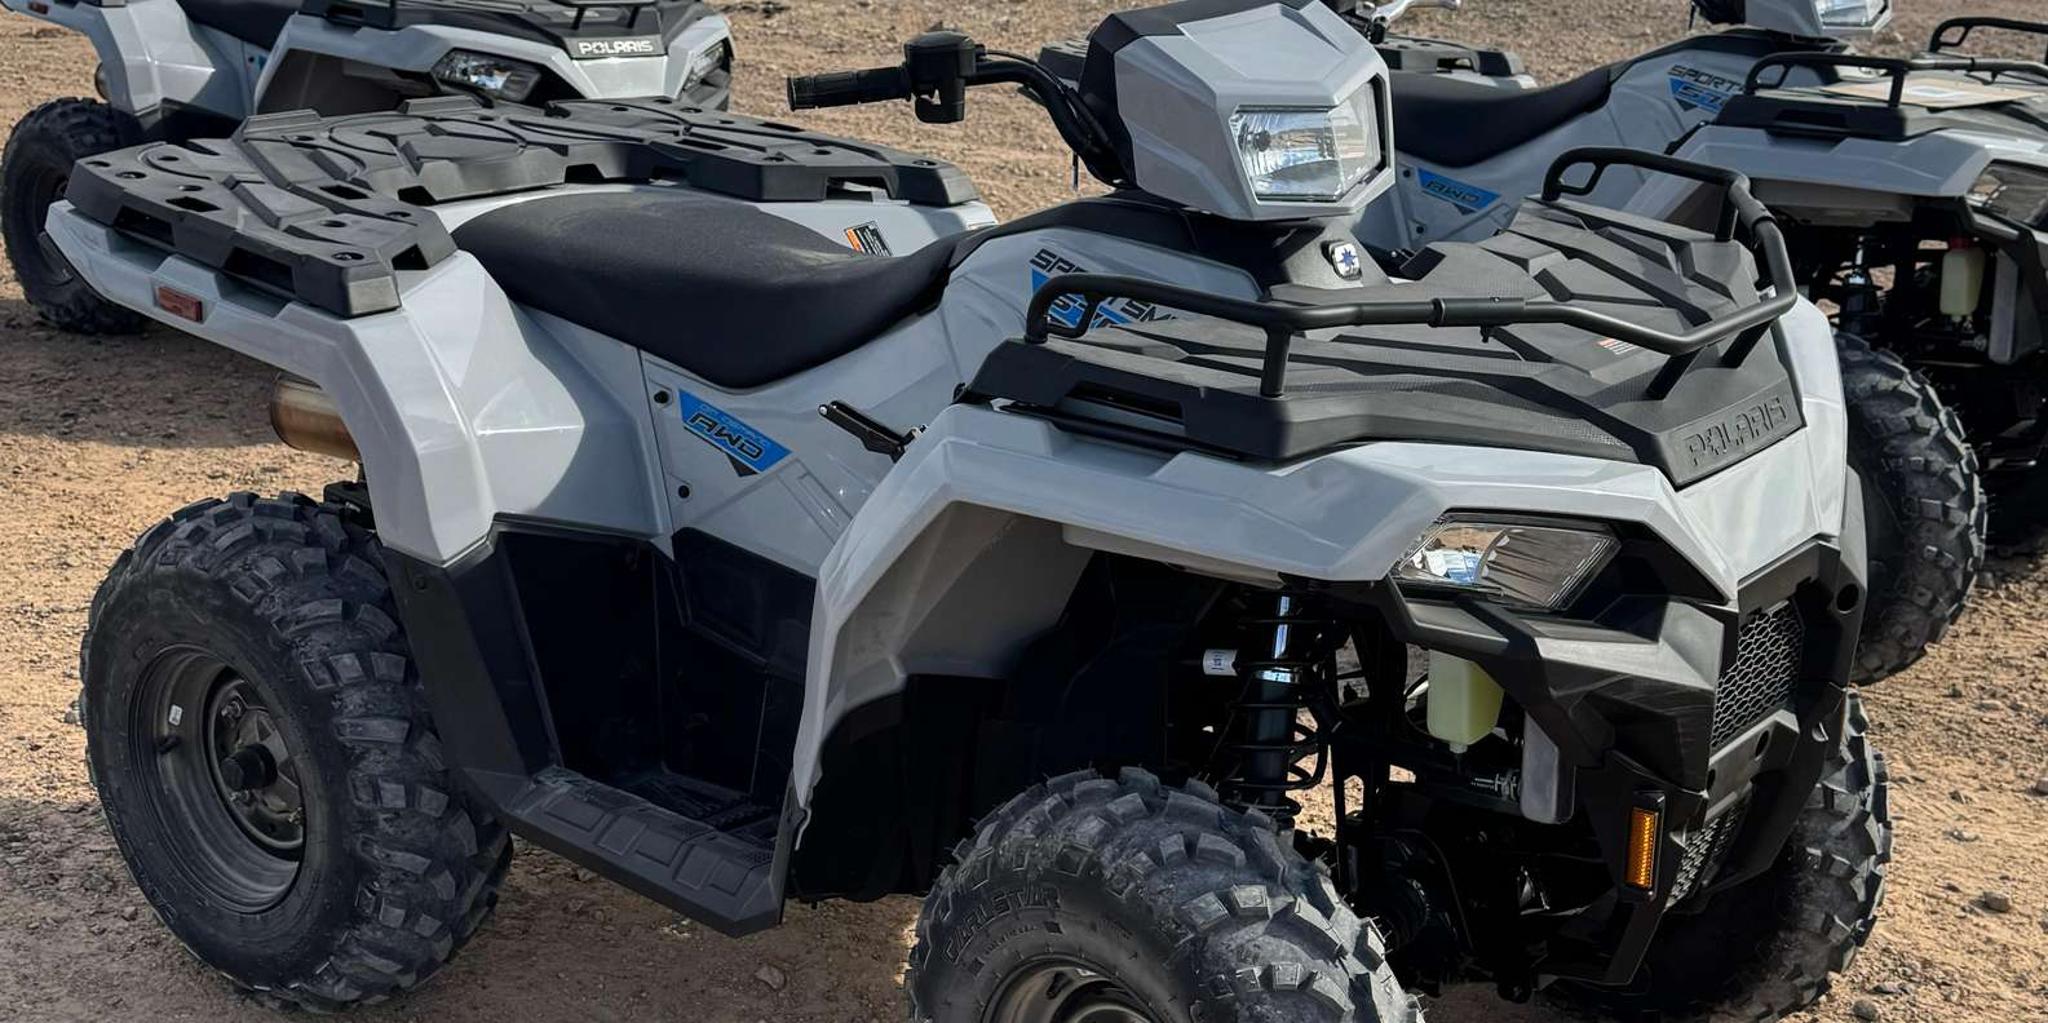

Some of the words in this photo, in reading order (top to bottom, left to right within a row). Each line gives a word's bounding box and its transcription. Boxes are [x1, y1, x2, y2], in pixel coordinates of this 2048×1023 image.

[578, 40, 654, 55] POLARIS
[687, 411, 764, 460] AWD
[1683, 396, 1788, 467] POLARIS
